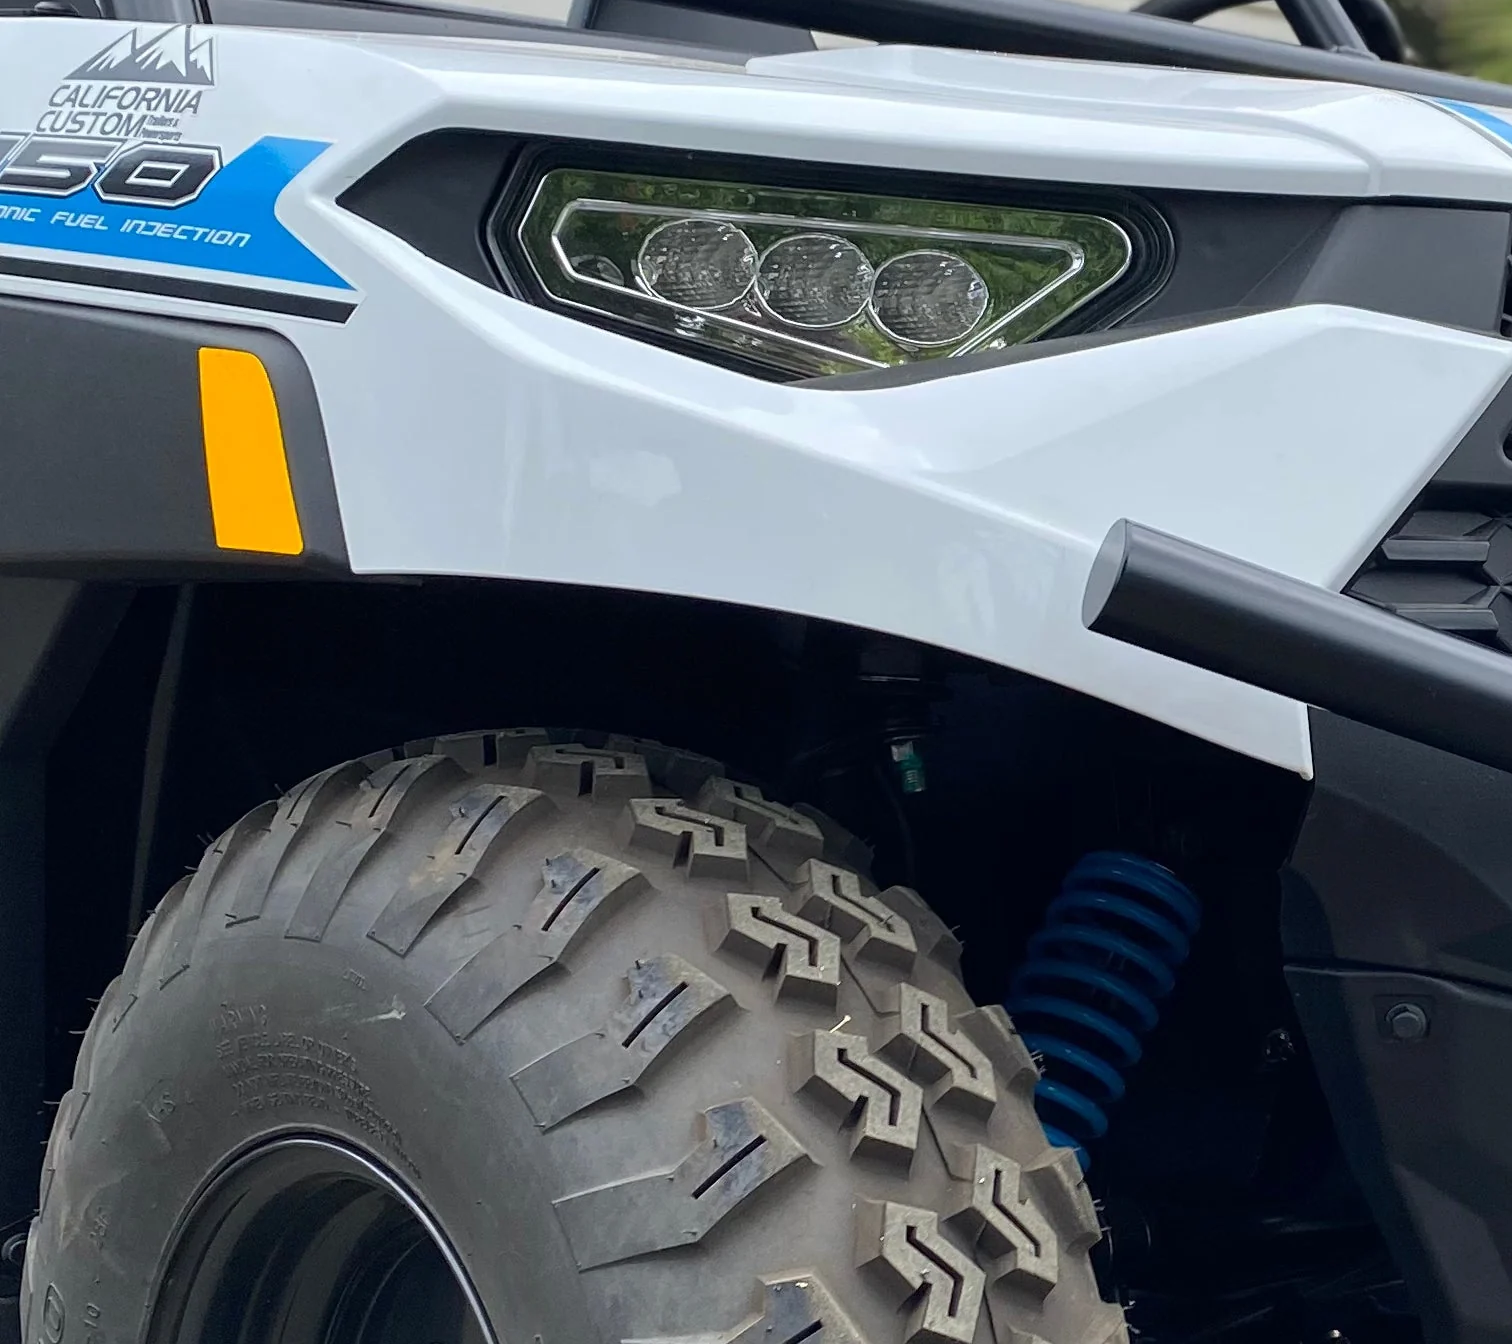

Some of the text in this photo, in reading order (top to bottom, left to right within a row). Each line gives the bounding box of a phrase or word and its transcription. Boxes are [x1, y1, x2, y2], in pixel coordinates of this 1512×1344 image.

[49, 84, 203, 114] CALIFORNIA
[36, 111, 148, 137] CUSTOM
[51, 211, 108, 231] FUEL
[120, 219, 252, 248] INJECTION
